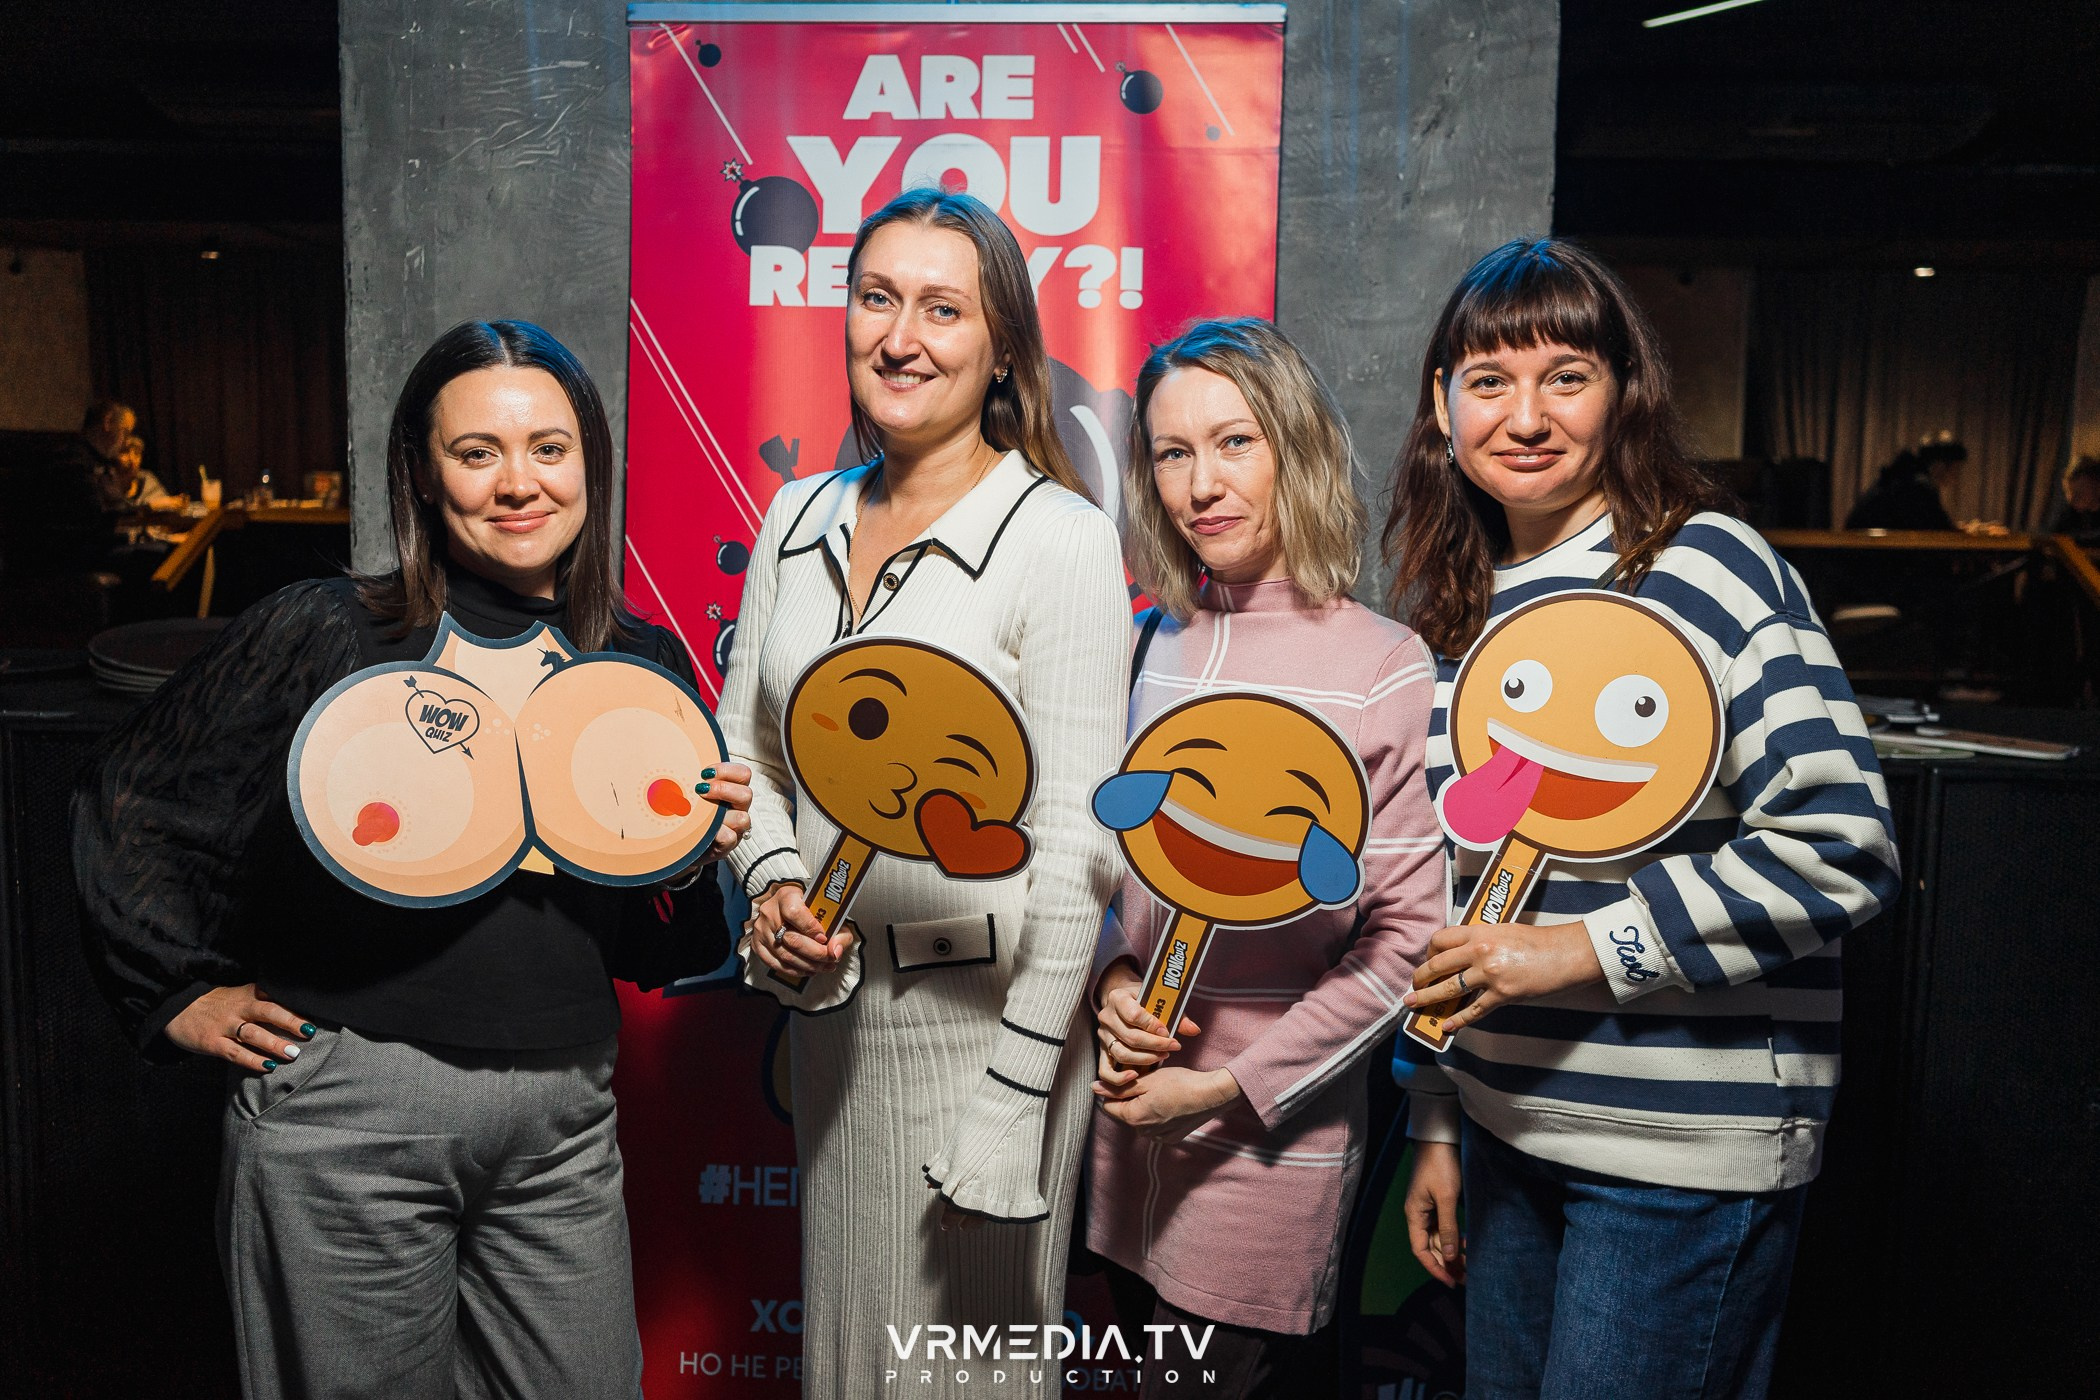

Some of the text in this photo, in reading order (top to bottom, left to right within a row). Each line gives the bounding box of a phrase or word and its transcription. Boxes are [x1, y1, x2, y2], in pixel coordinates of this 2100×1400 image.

[842, 54, 1036, 120] ARE
[786, 132, 1101, 236] YOU
[749, 243, 1144, 310] RE?!
[419, 704, 469, 732] WOW
[425, 726, 453, 742] QUIZ
[680, 1351, 722, 1376] НО
[731, 1354, 767, 1379] НЕ
